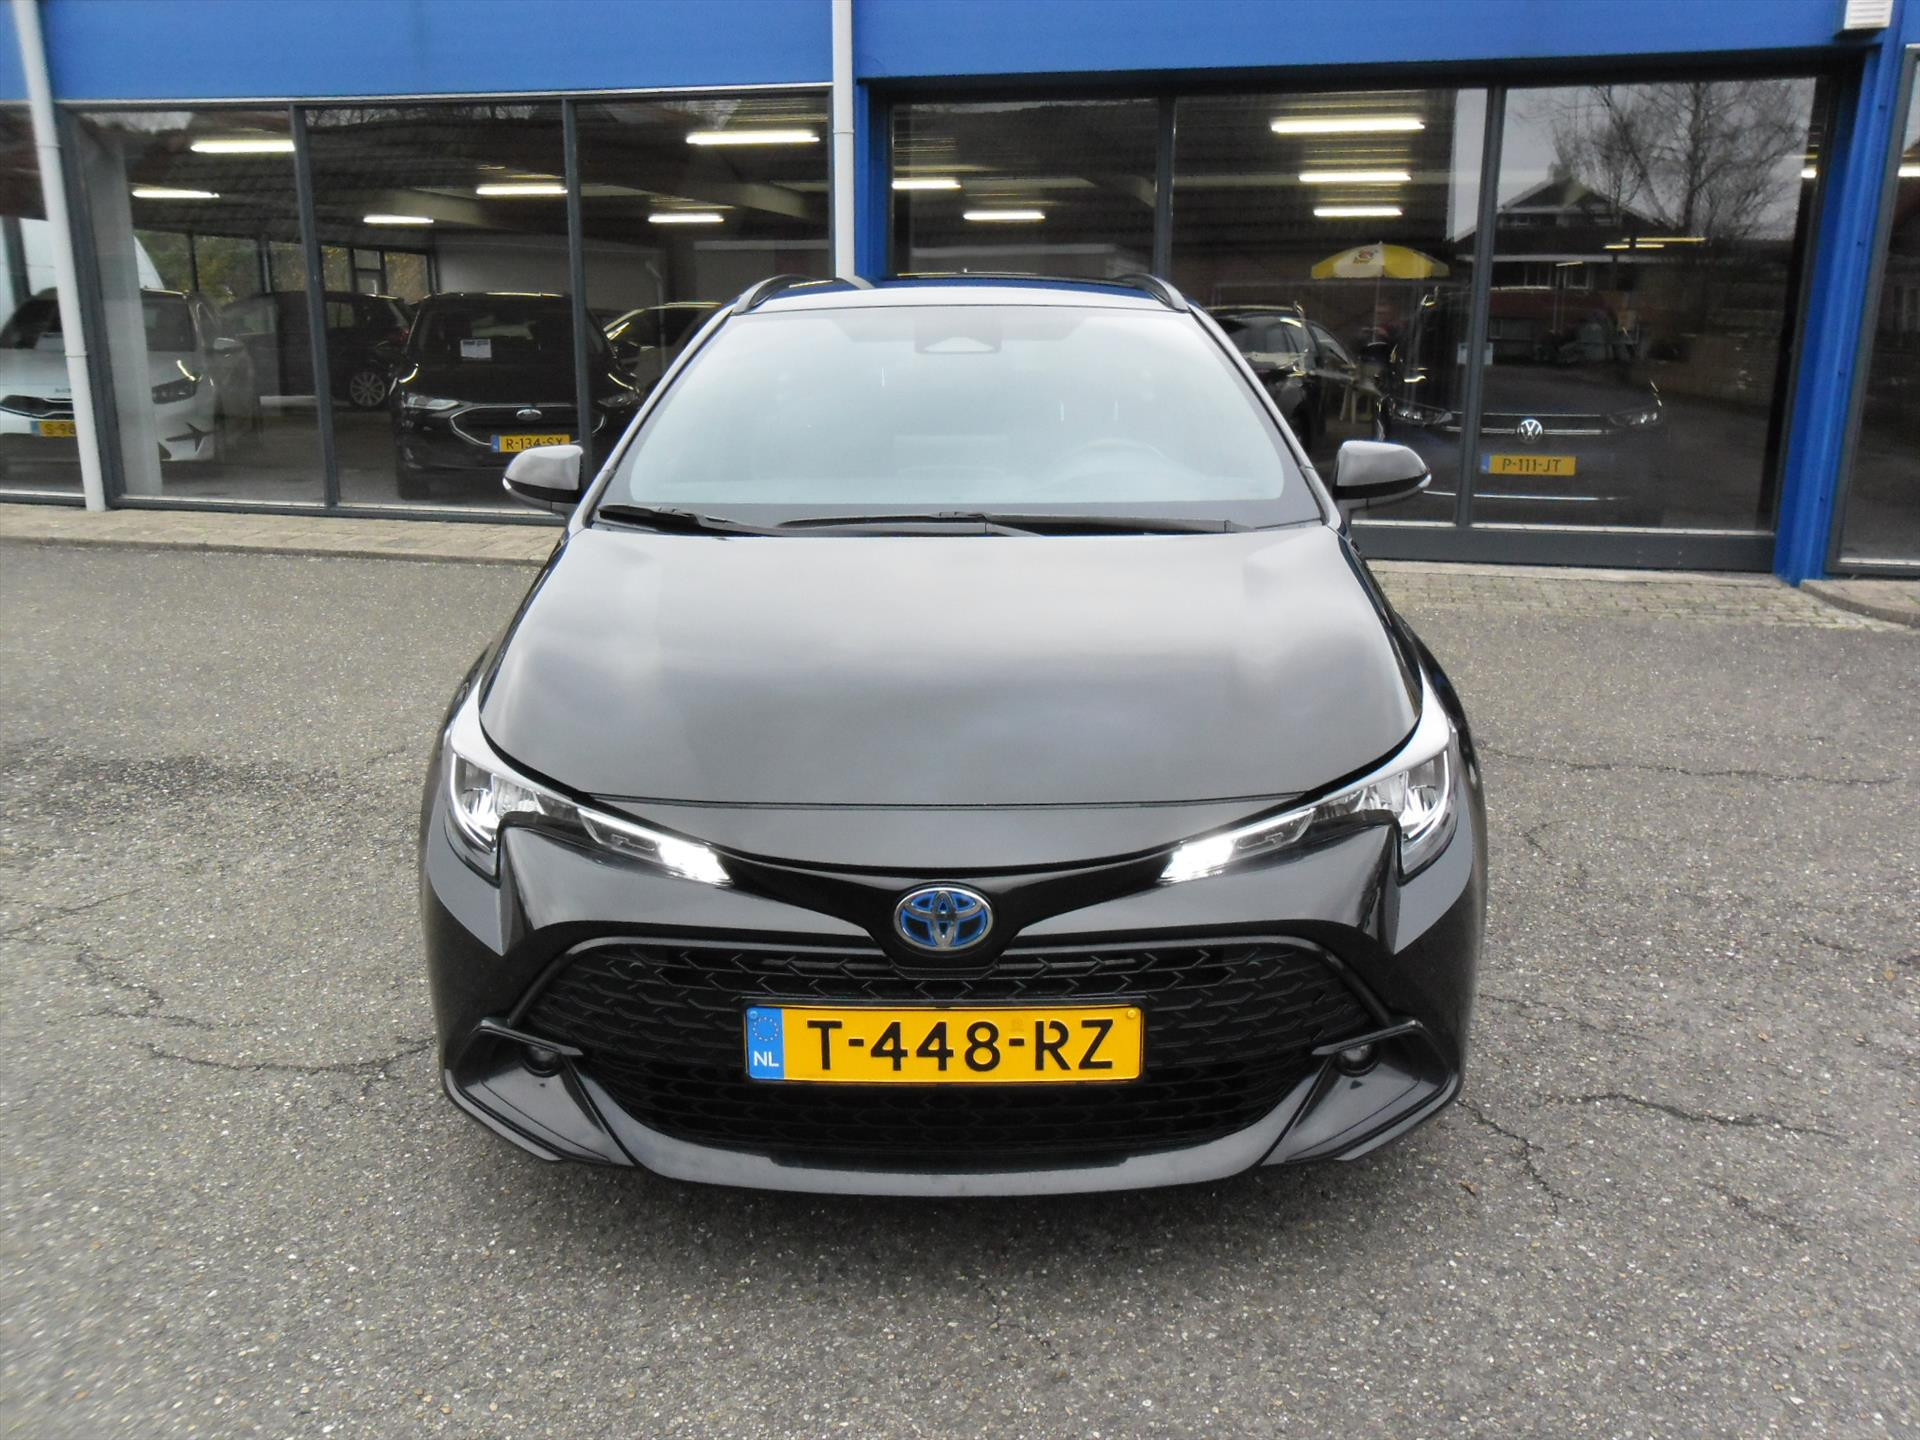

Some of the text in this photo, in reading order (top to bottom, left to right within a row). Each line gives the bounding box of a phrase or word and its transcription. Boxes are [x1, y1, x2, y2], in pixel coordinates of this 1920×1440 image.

[1502, 458, 1561, 472] P-111-JT
[807, 1019, 1114, 1071] T-448-RZ
[754, 1051, 779, 1066] NL
